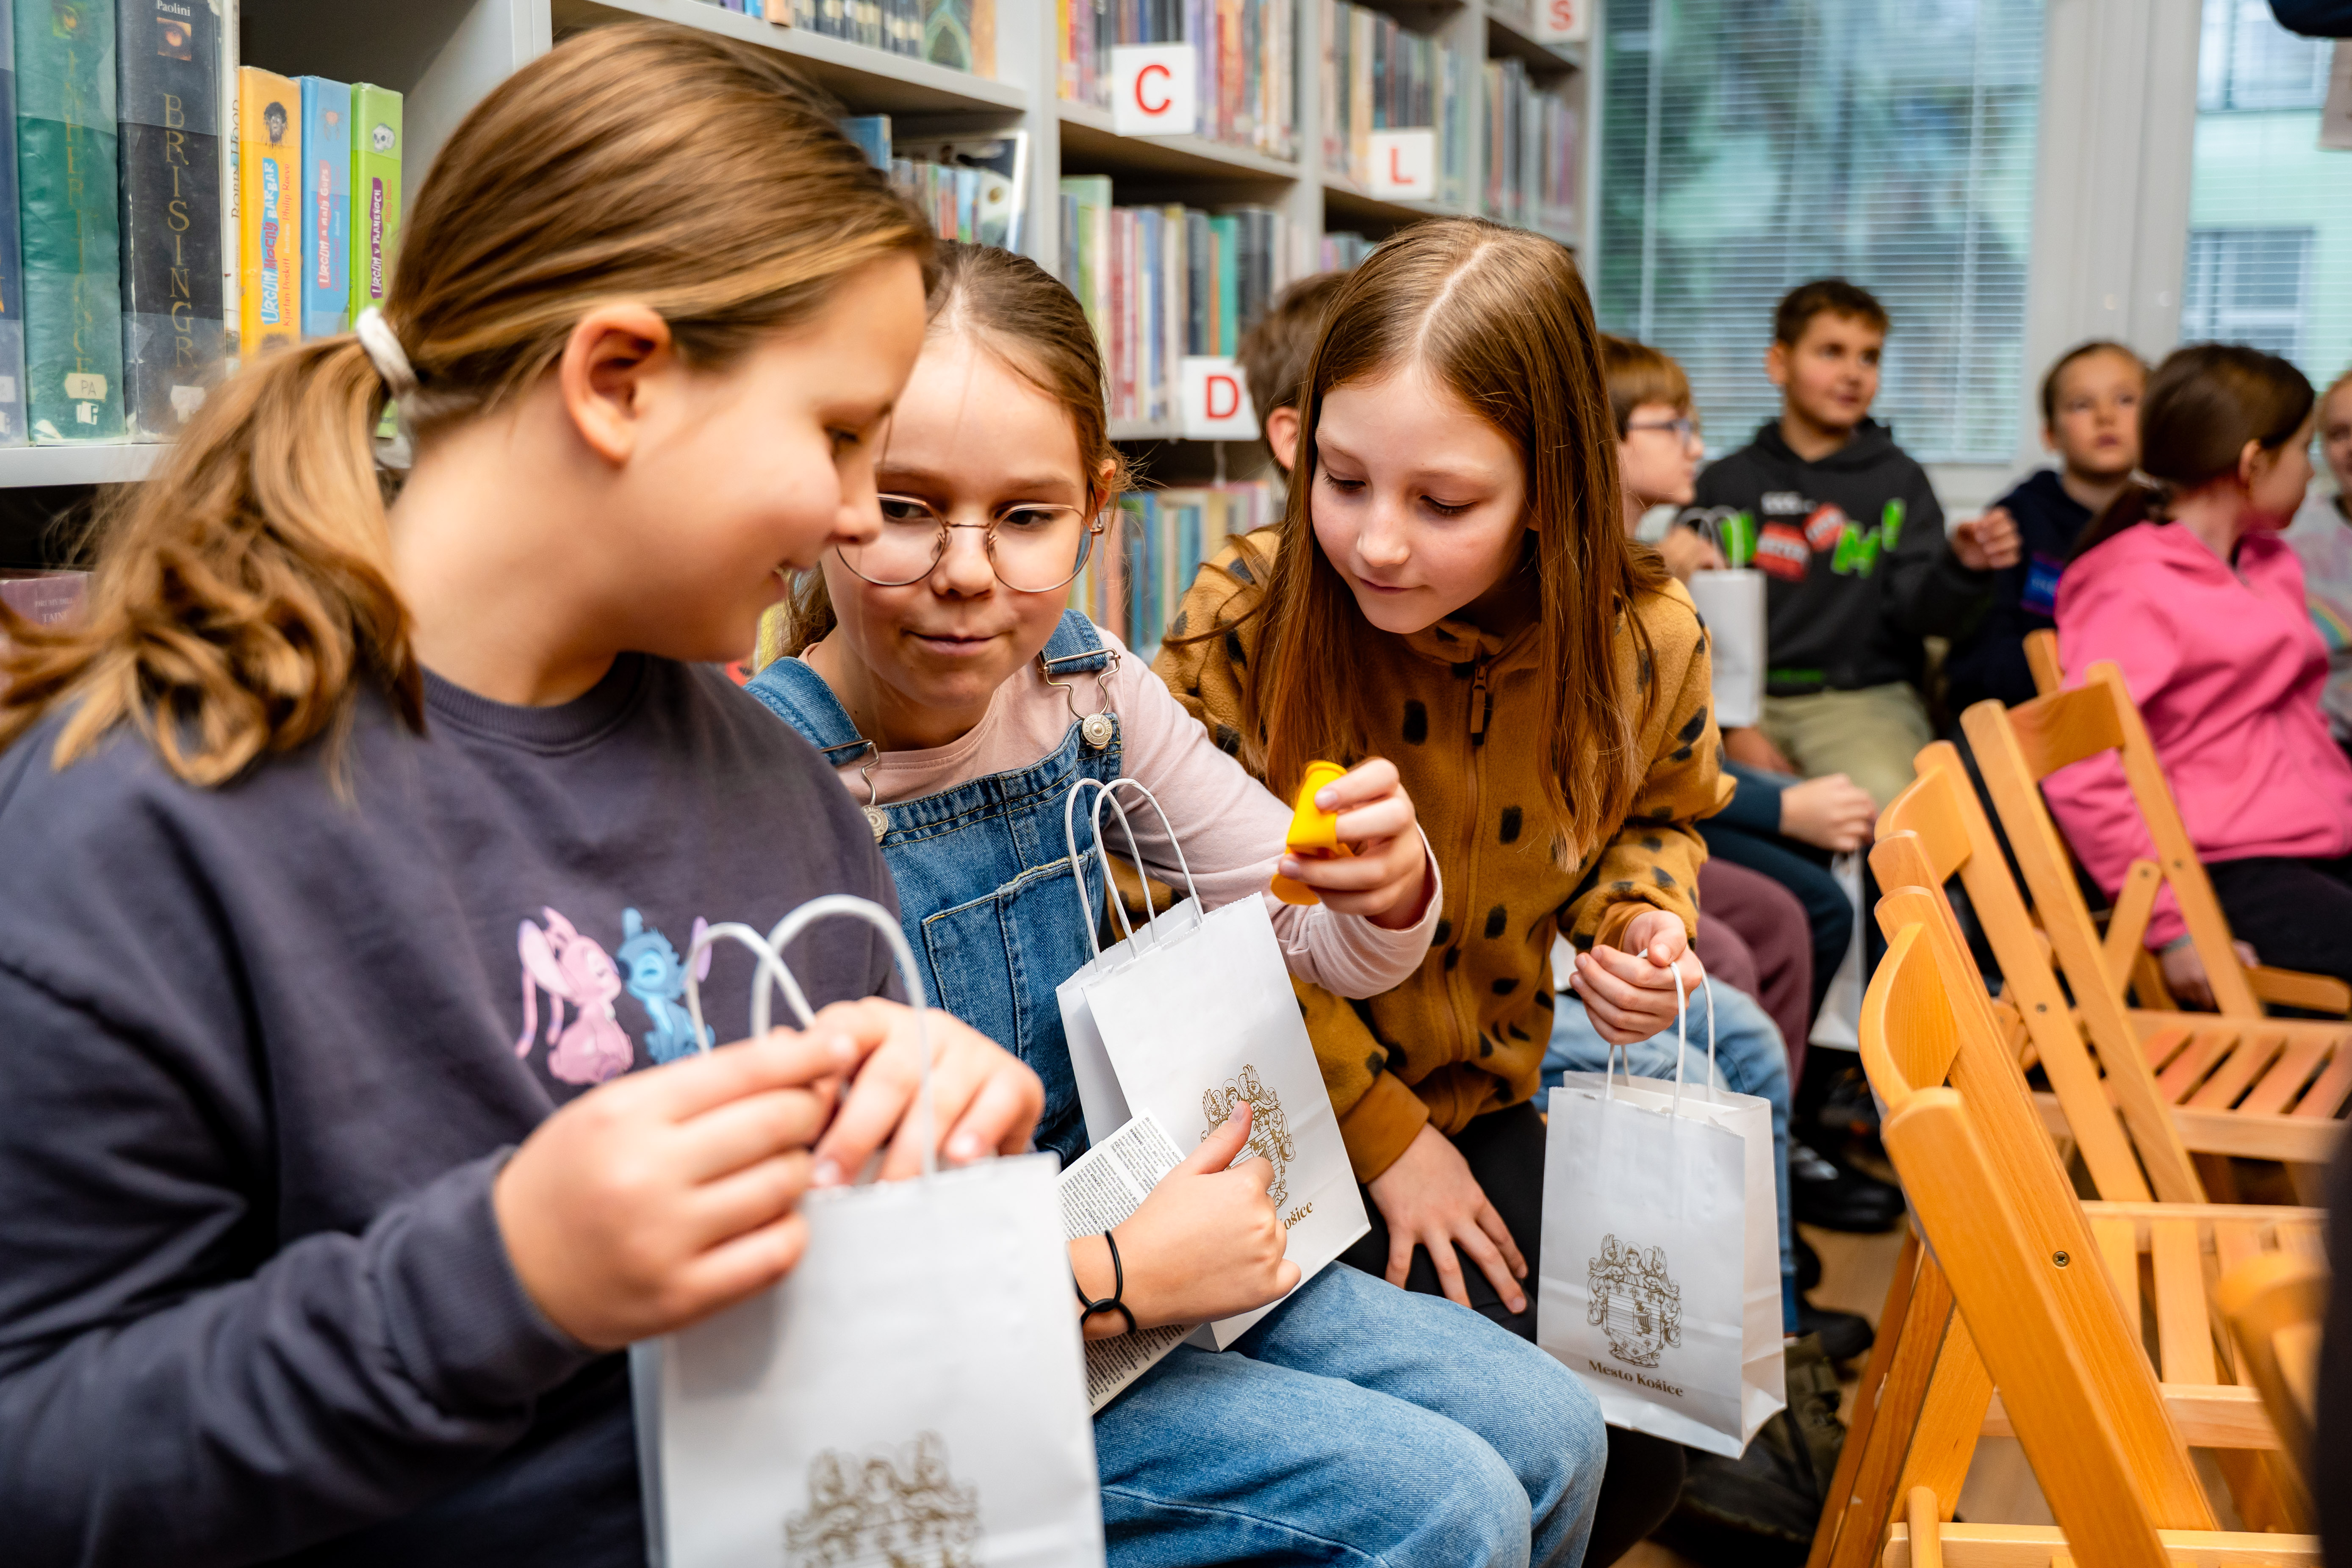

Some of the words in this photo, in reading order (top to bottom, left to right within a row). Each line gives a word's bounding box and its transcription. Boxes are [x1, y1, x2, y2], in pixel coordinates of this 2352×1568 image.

[157, 0, 190, 17] Paolini
[1549, 0, 1575, 31] S
[1135, 64, 1172, 116] C
[1390, 147, 1414, 185] L
[264, 162, 278, 219] BARBAR
[283, 194, 292, 221] Philip
[163, 93, 198, 368] BRISINGR
[371, 257, 382, 293] URGUM
[81, 380, 97, 396] PA
[1206, 375, 1240, 420] D
[1095, 1156, 1105, 1168] menores
[1172, 1151, 1182, 1164] ACHTUN
[1068, 1178, 1080, 1192] packaging
[1084, 1199, 1093, 1210] children
[1097, 1174, 1107, 1187] Conserve
[1116, 1175, 1126, 1188] Vyrobeno
[1067, 1193, 1076, 1204] pouvant
[1072, 1175, 1081, 1186] children
[1097, 1207, 1105, 1219] Choking
[1104, 1217, 1113, 1227] hazard
[1103, 1191, 1111, 1200] indicat
[1064, 1197, 1072, 1207] enfants
[1073, 1210, 1083, 1222] puissent
[1085, 1208, 1098, 1224] ATTENTION
[1280, 1202, 1313, 1230] ošice
[1589, 1359, 1633, 1382] Mesto
[1636, 1372, 1683, 1396] Košice
